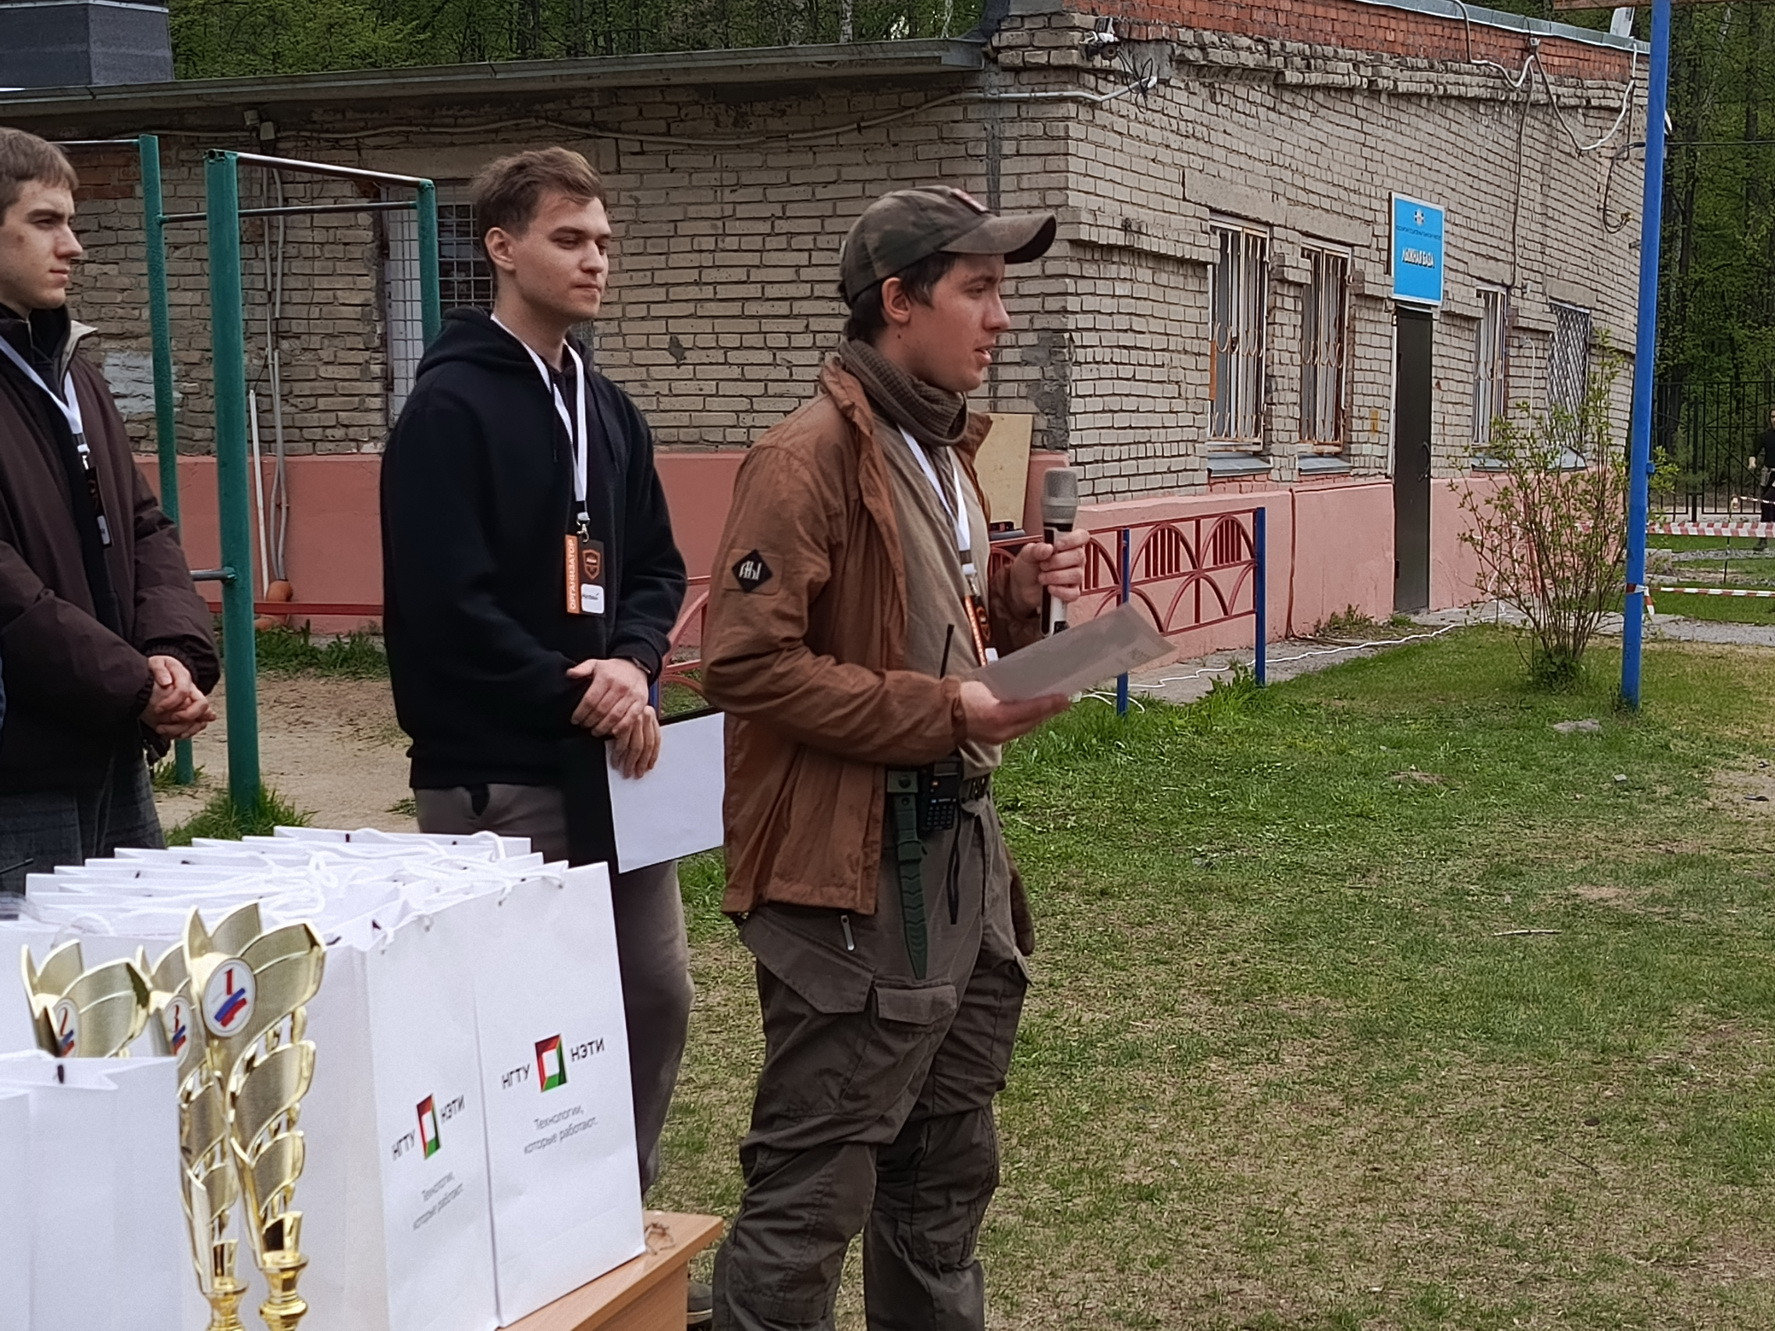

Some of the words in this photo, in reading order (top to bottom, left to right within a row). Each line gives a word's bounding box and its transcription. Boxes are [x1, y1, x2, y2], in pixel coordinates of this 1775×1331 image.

[223, 967, 234, 996] 1
[501, 1062, 531, 1090] НГТУ
[570, 1037, 605, 1062] НЭТИ
[391, 1128, 416, 1161] НГТУ
[440, 1094, 465, 1124] НЭТИ
